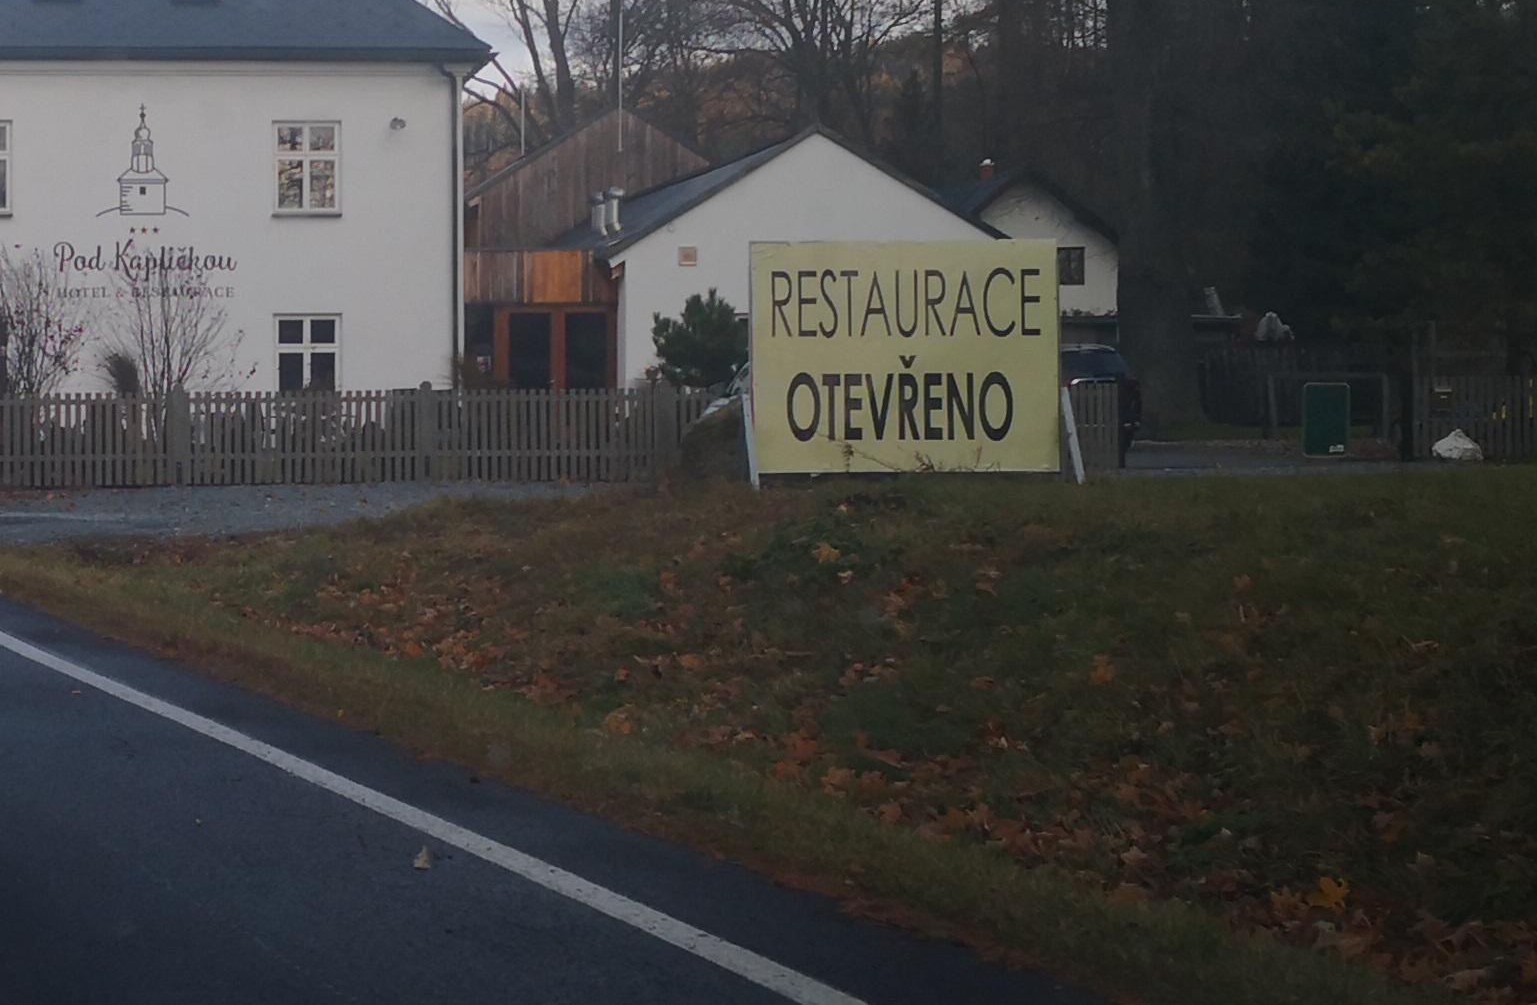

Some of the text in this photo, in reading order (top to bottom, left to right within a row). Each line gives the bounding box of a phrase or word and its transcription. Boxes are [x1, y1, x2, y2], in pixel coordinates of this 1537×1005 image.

[53, 239, 238, 282] Pod Kapličkou
[57, 286, 109, 298] HOTEL
[771, 267, 1041, 338] RESTAURACE
[786, 355, 1013, 442] OTEVŘENO
